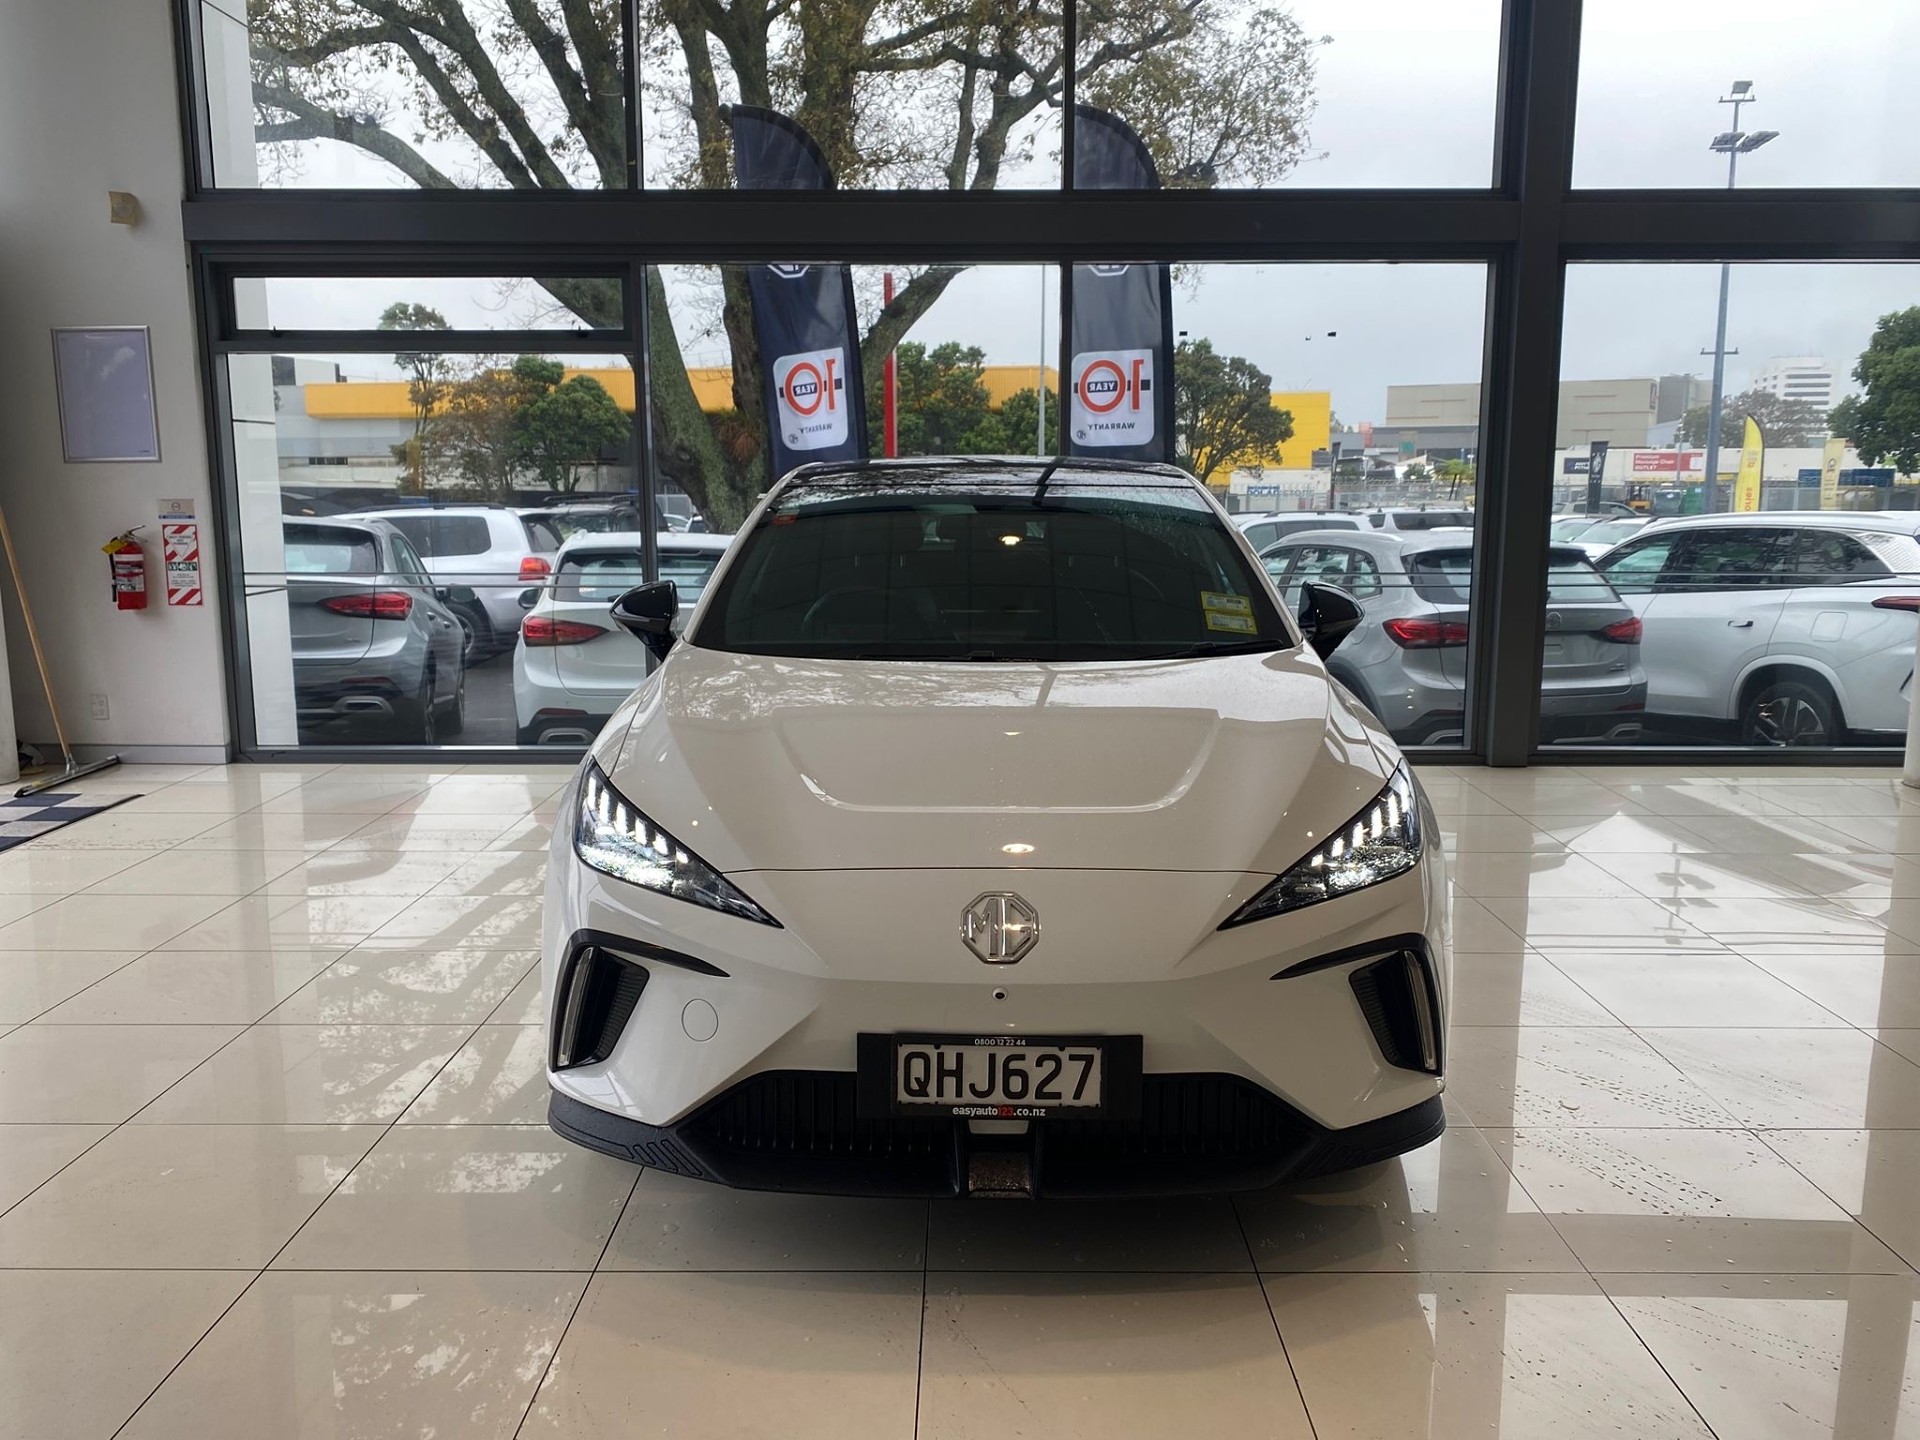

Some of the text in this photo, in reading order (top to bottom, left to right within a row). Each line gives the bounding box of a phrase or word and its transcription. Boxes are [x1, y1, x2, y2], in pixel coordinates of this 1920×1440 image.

[963, 893, 1036, 962] MG
[974, 1038, 1026, 1047] 0800 12 22 44
[903, 1051, 1095, 1100] QHJ627
[952, 1106, 1046, 1118] easyauto123.co.nz
